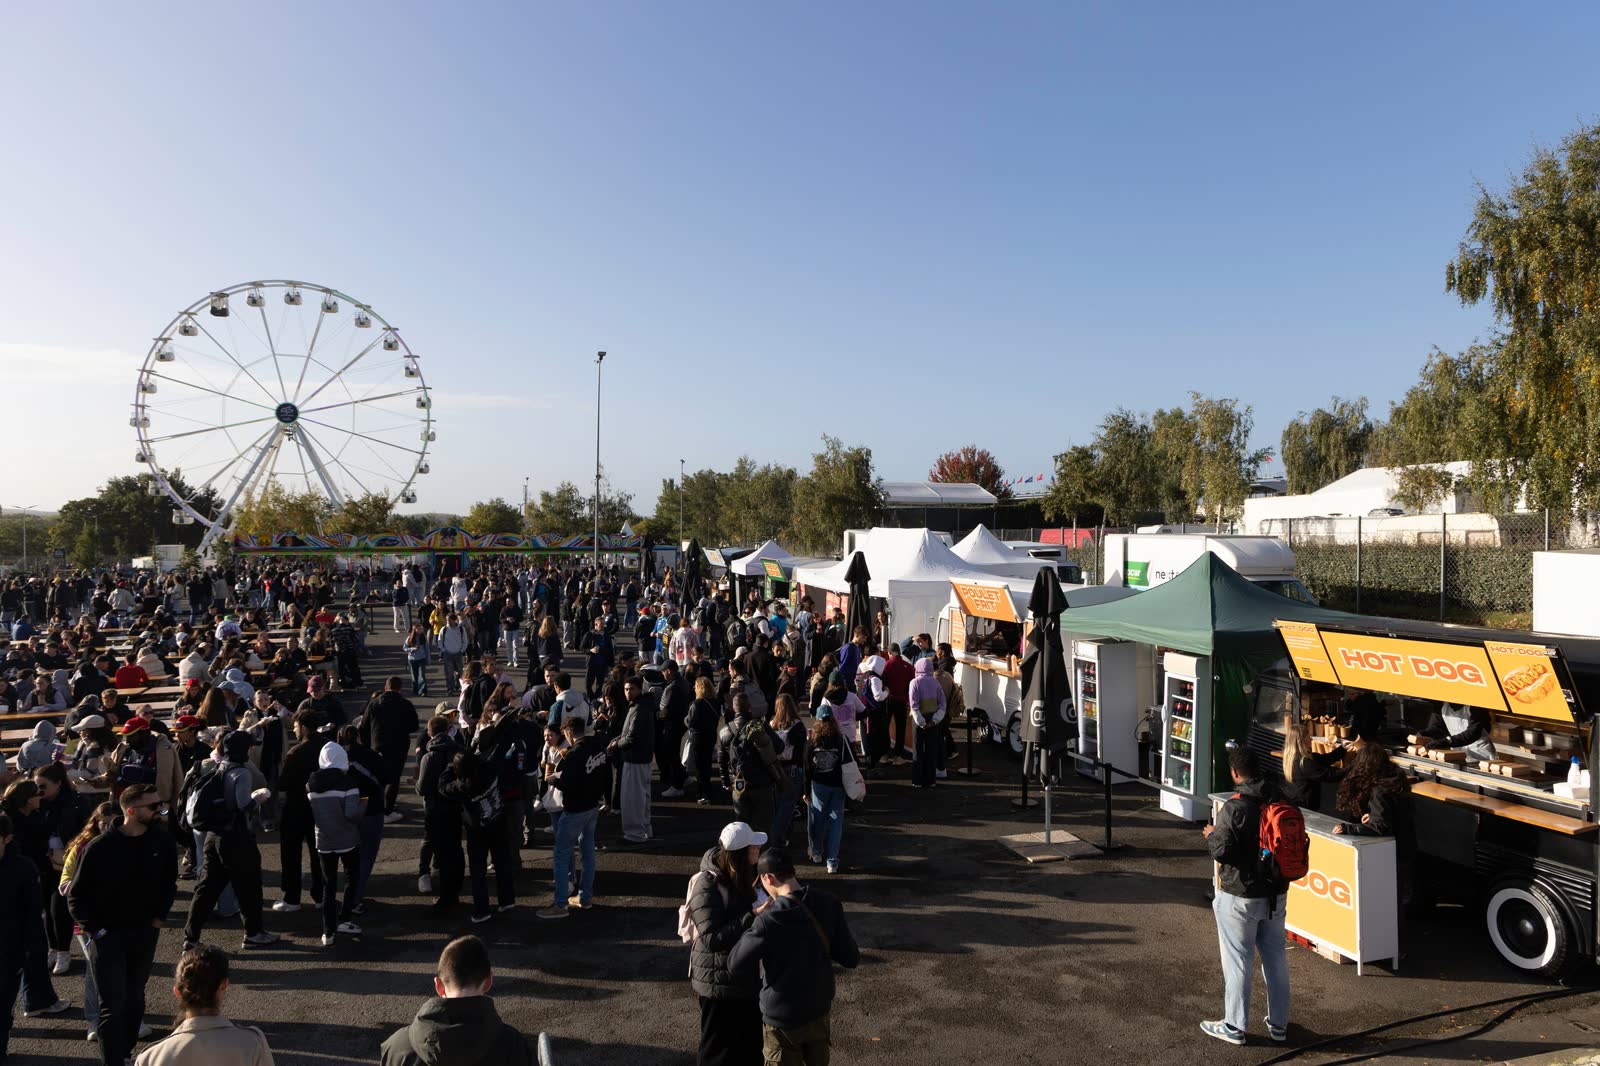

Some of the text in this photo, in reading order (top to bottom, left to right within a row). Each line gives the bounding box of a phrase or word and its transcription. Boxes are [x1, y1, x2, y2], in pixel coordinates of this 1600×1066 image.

[960, 586, 1000, 602] POULET
[973, 599, 997, 612] FRIT
[1490, 645, 1544, 656] HOT DOG
[1338, 648, 1487, 686] HOT DOG
